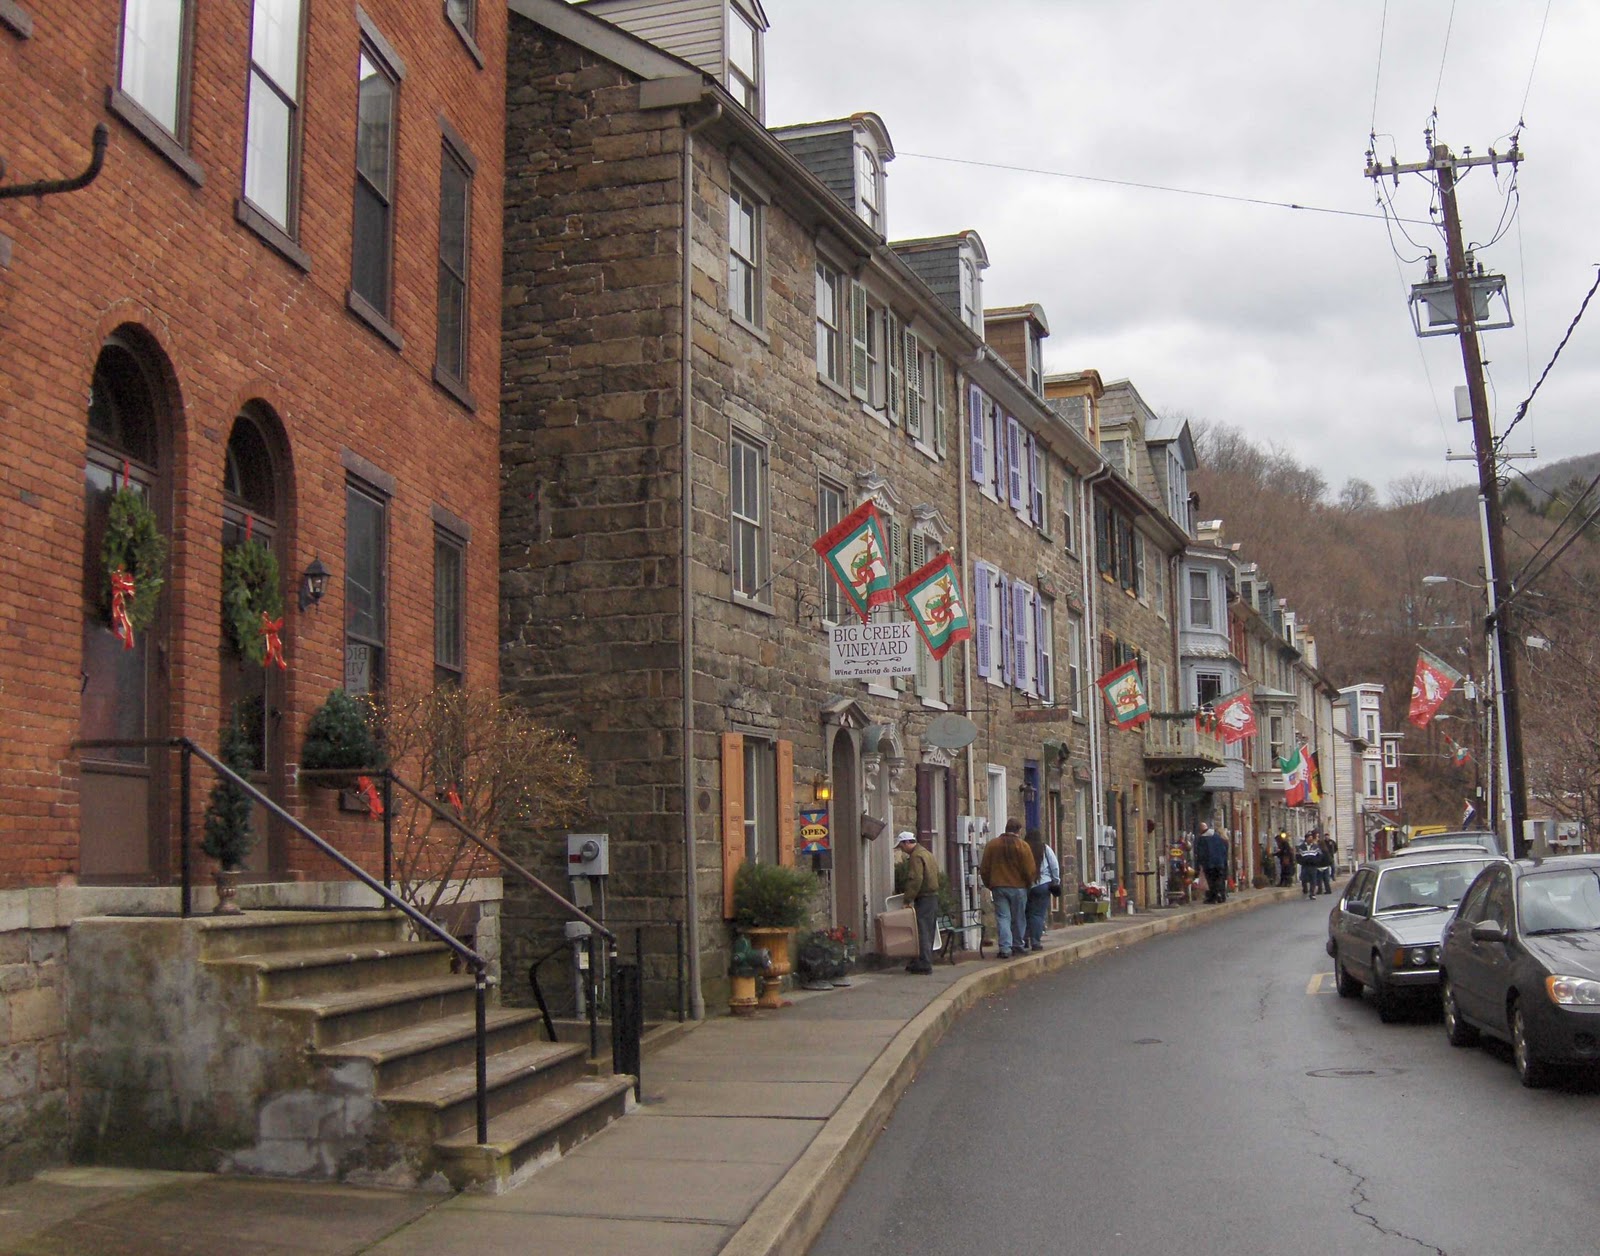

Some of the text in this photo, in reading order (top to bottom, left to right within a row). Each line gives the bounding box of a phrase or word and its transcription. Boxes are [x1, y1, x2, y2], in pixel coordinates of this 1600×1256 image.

[834, 625, 911, 642] BIG CREEK
[836, 641, 908, 657] VINEYARD
[854, 667, 881, 676] Tasting
